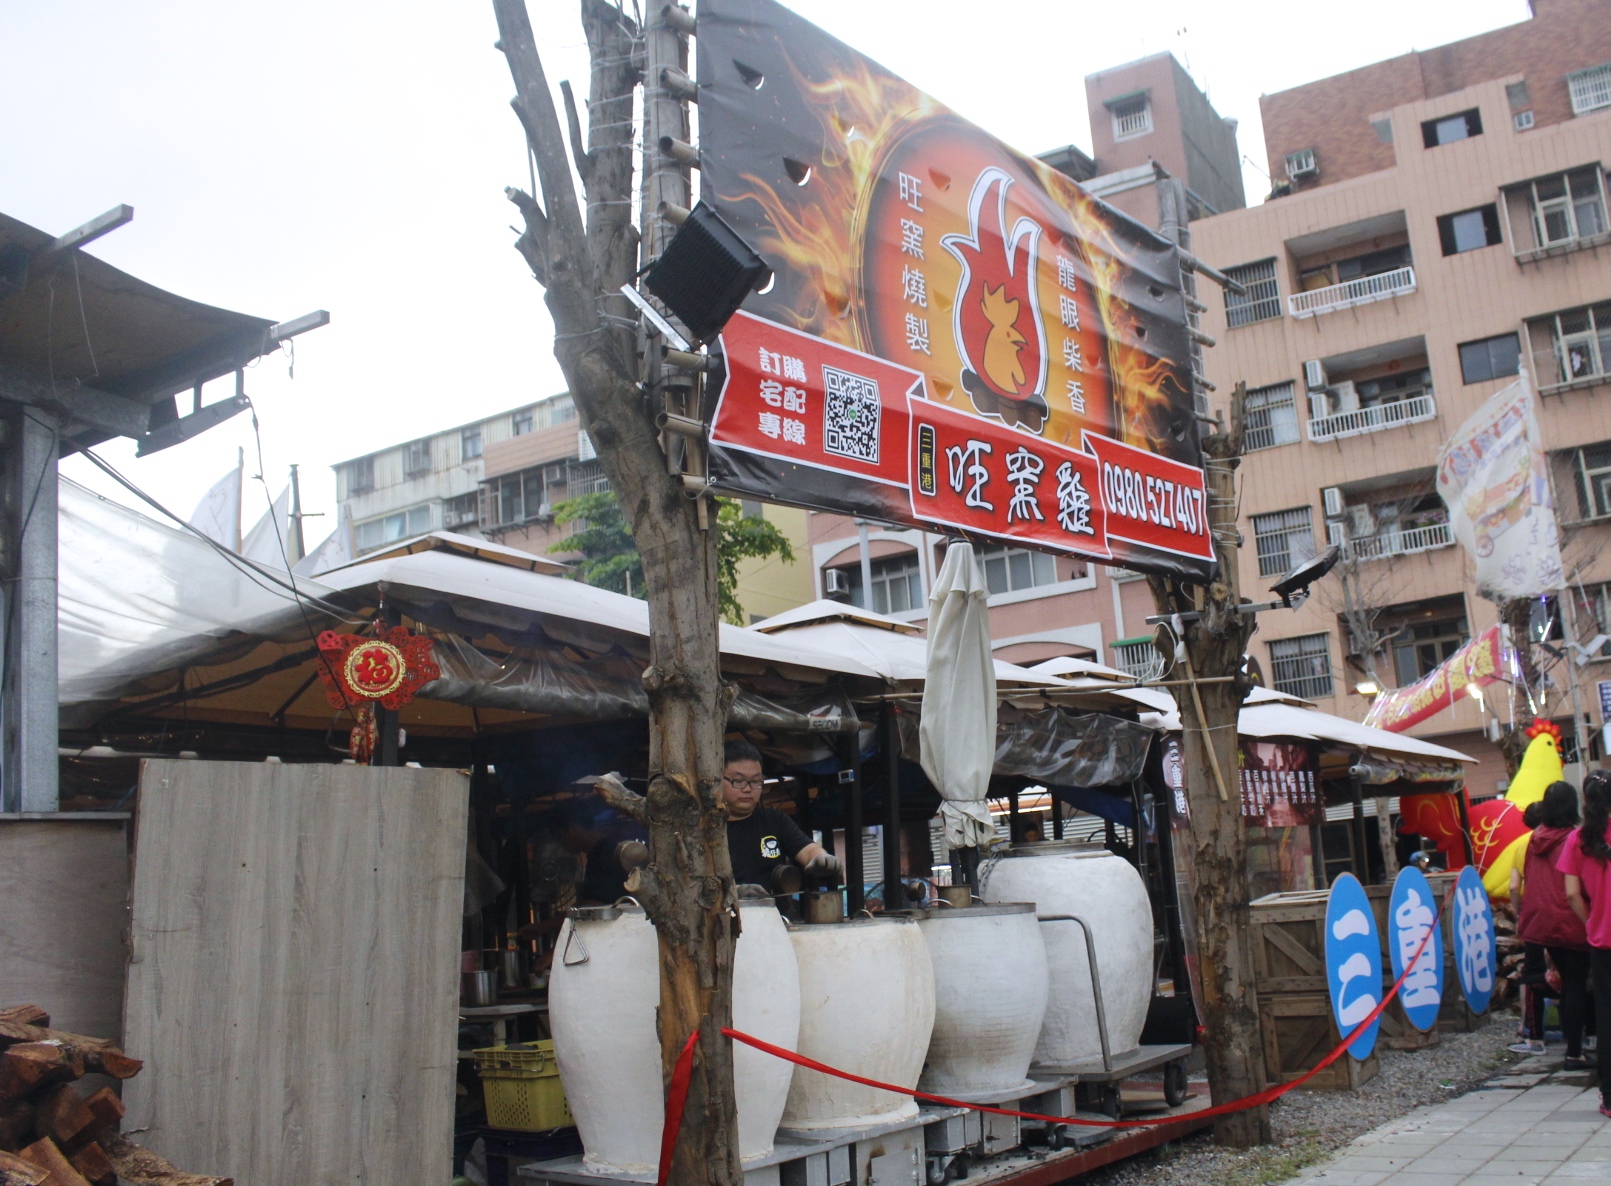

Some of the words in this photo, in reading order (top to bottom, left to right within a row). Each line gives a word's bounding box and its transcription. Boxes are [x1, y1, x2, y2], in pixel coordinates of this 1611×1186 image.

[898, 171, 931, 355] 旺窯燒製
[1055, 254, 1086, 414] 龍眼柴香
[758, 346, 807, 383] 訂購
[759, 379, 807, 414] 宅配
[758, 411, 806, 445] 專線
[921, 432, 932, 489] 三重港
[945, 439, 1095, 536] 旺窯雞
